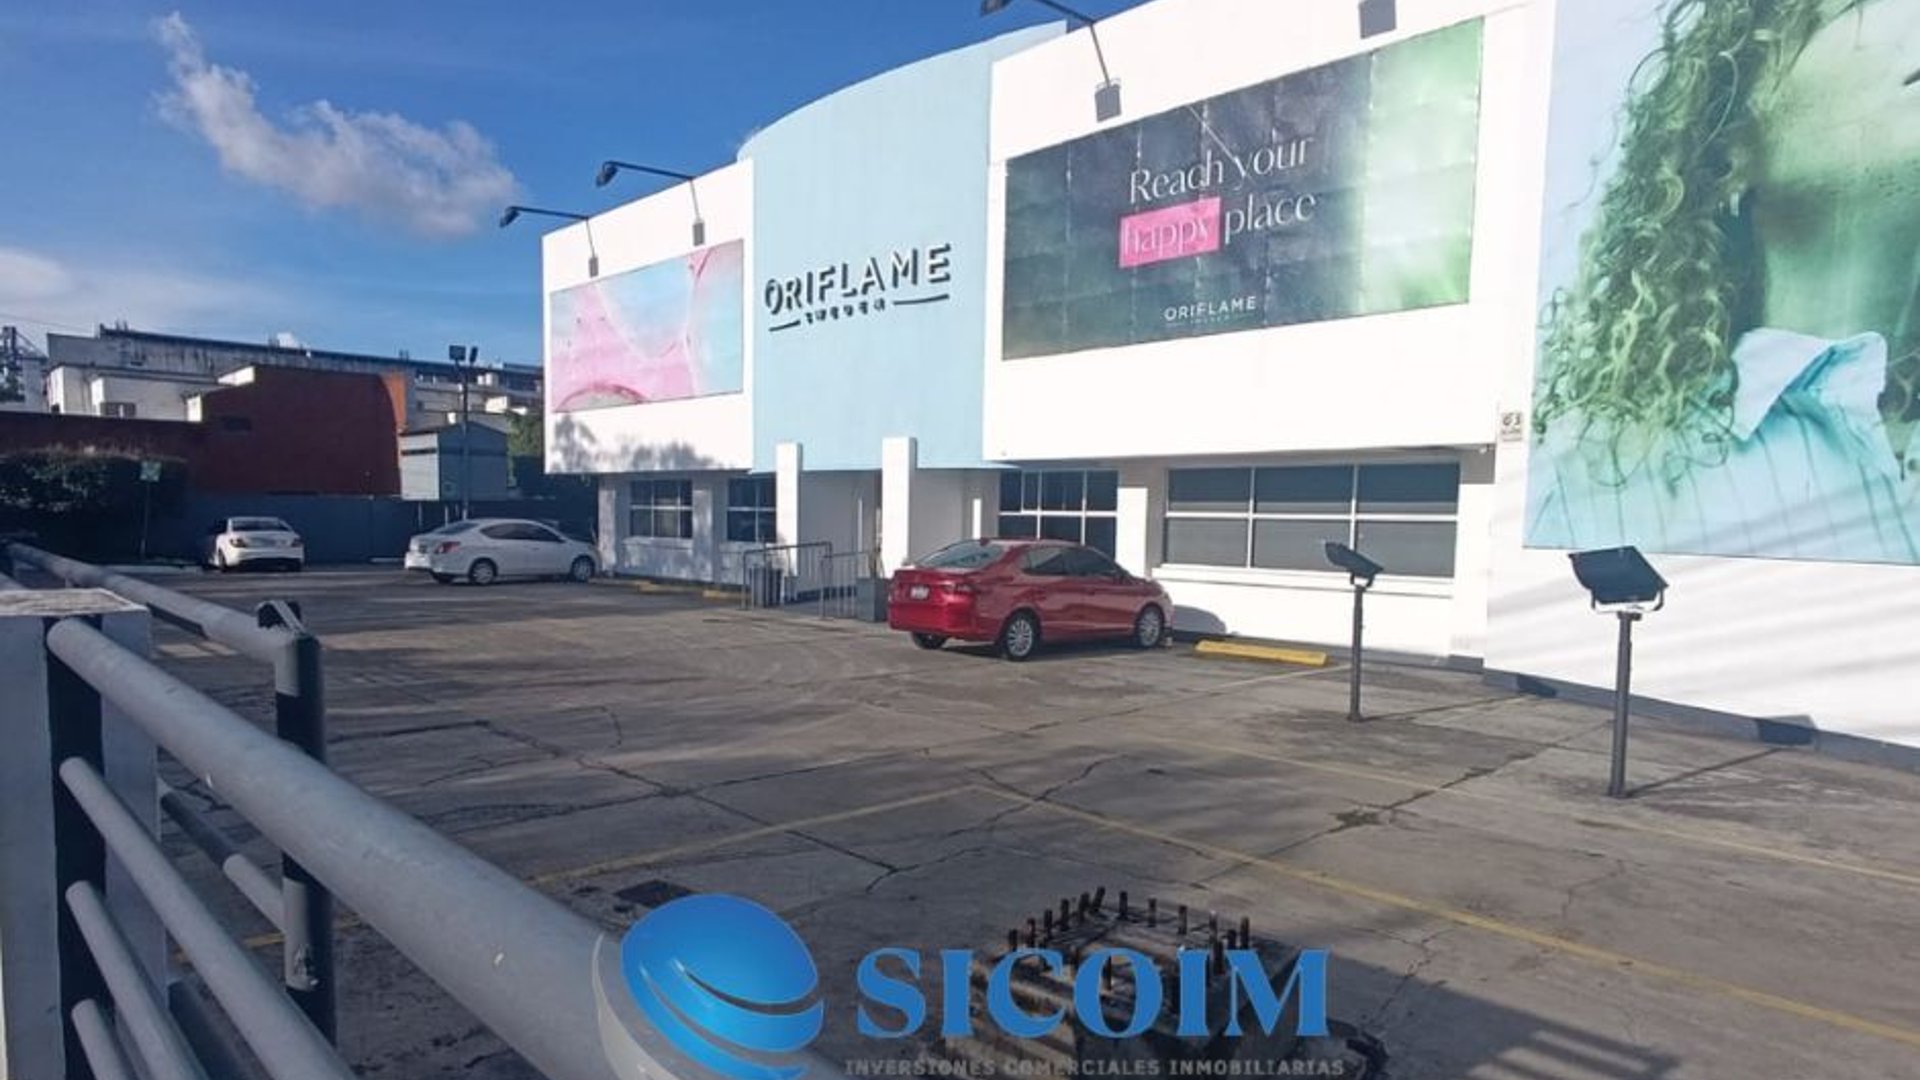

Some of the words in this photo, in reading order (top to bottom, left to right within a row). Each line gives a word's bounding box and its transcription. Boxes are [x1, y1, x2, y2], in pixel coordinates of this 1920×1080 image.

[1130, 149, 1224, 204] Reach
[1231, 137, 1315, 191] your
[1122, 216, 1210, 260] happy
[1223, 193, 1317, 245] place
[764, 243, 952, 315] ORIFLAME
[1163, 295, 1257, 322] ORIFLAME
